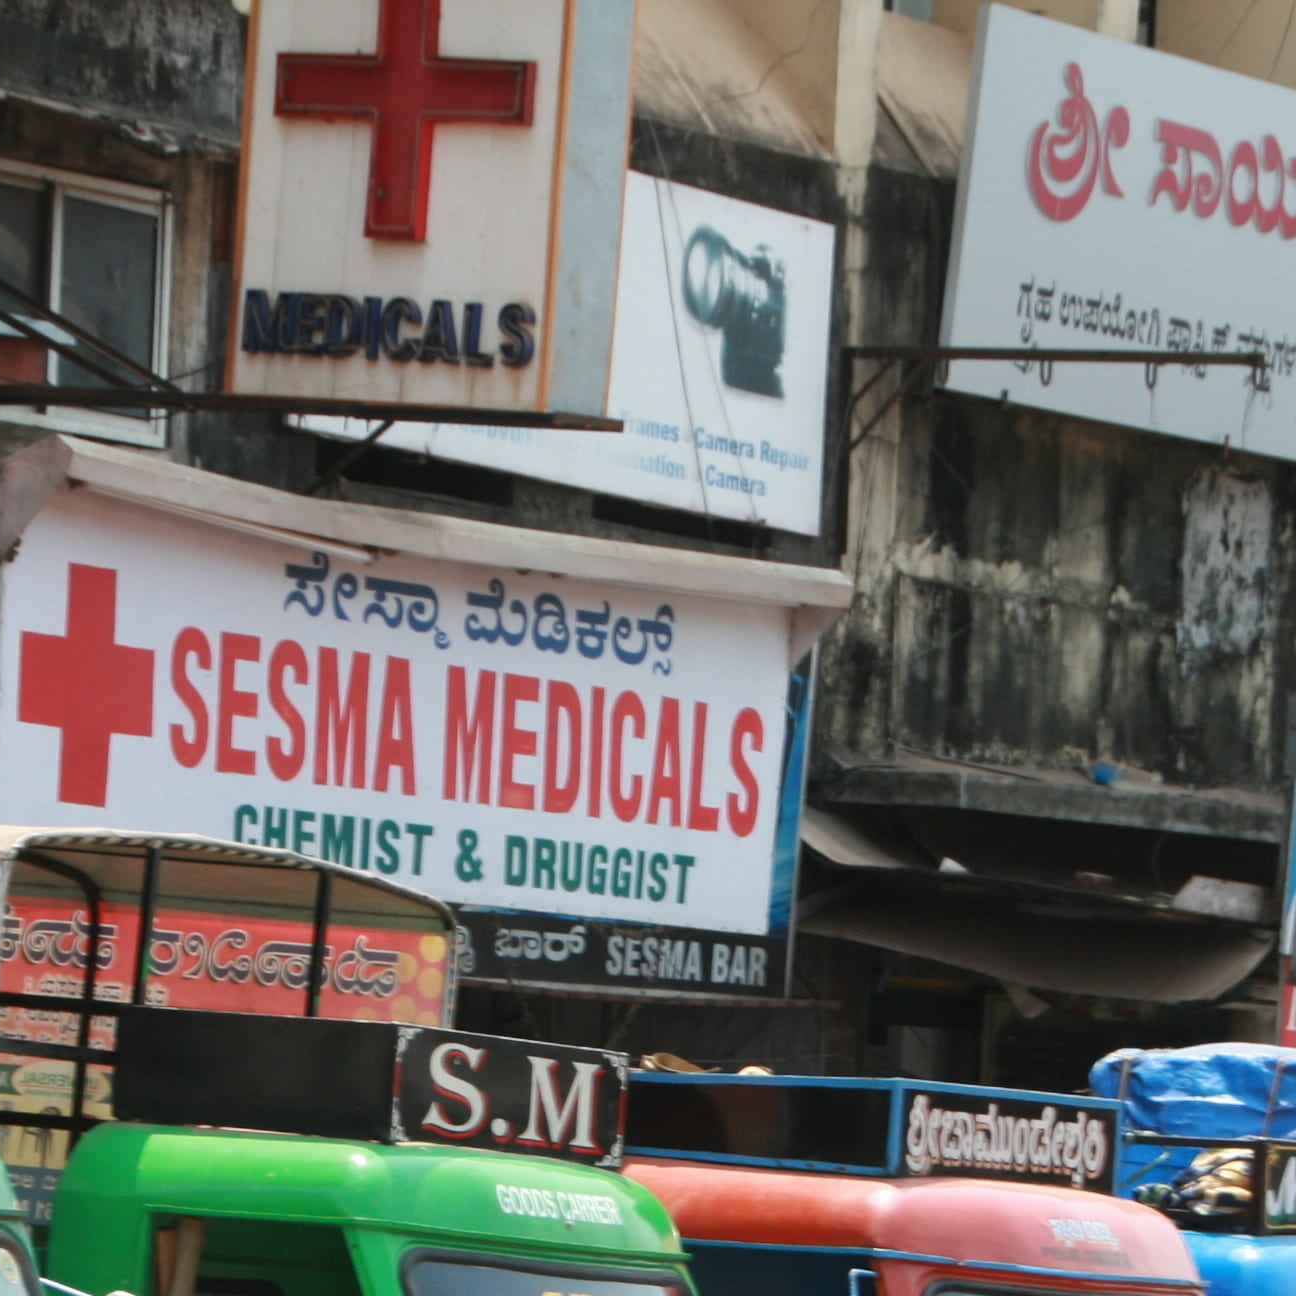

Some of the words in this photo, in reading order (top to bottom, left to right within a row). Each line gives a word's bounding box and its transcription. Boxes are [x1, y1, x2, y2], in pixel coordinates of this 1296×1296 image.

[1026, 61, 1130, 224] ಶ್ರೀ
[241, 288, 537, 368] MEDICALS
[693, 426, 756, 462] Camera
[759, 438, 812, 473] Repair
[705, 465, 767, 499] Camera
[168, 625, 417, 797] SESMA
[443, 664, 766, 839] MEDICALS
[234, 803, 433, 878] CHEMIST
[454, 829, 484, 884] &
[505, 835, 697, 906] DRUGGIST
[605, 935, 703, 983] SESMA
[711, 941, 768, 988] BAR
[495, 1183, 560, 1220] GOODS
